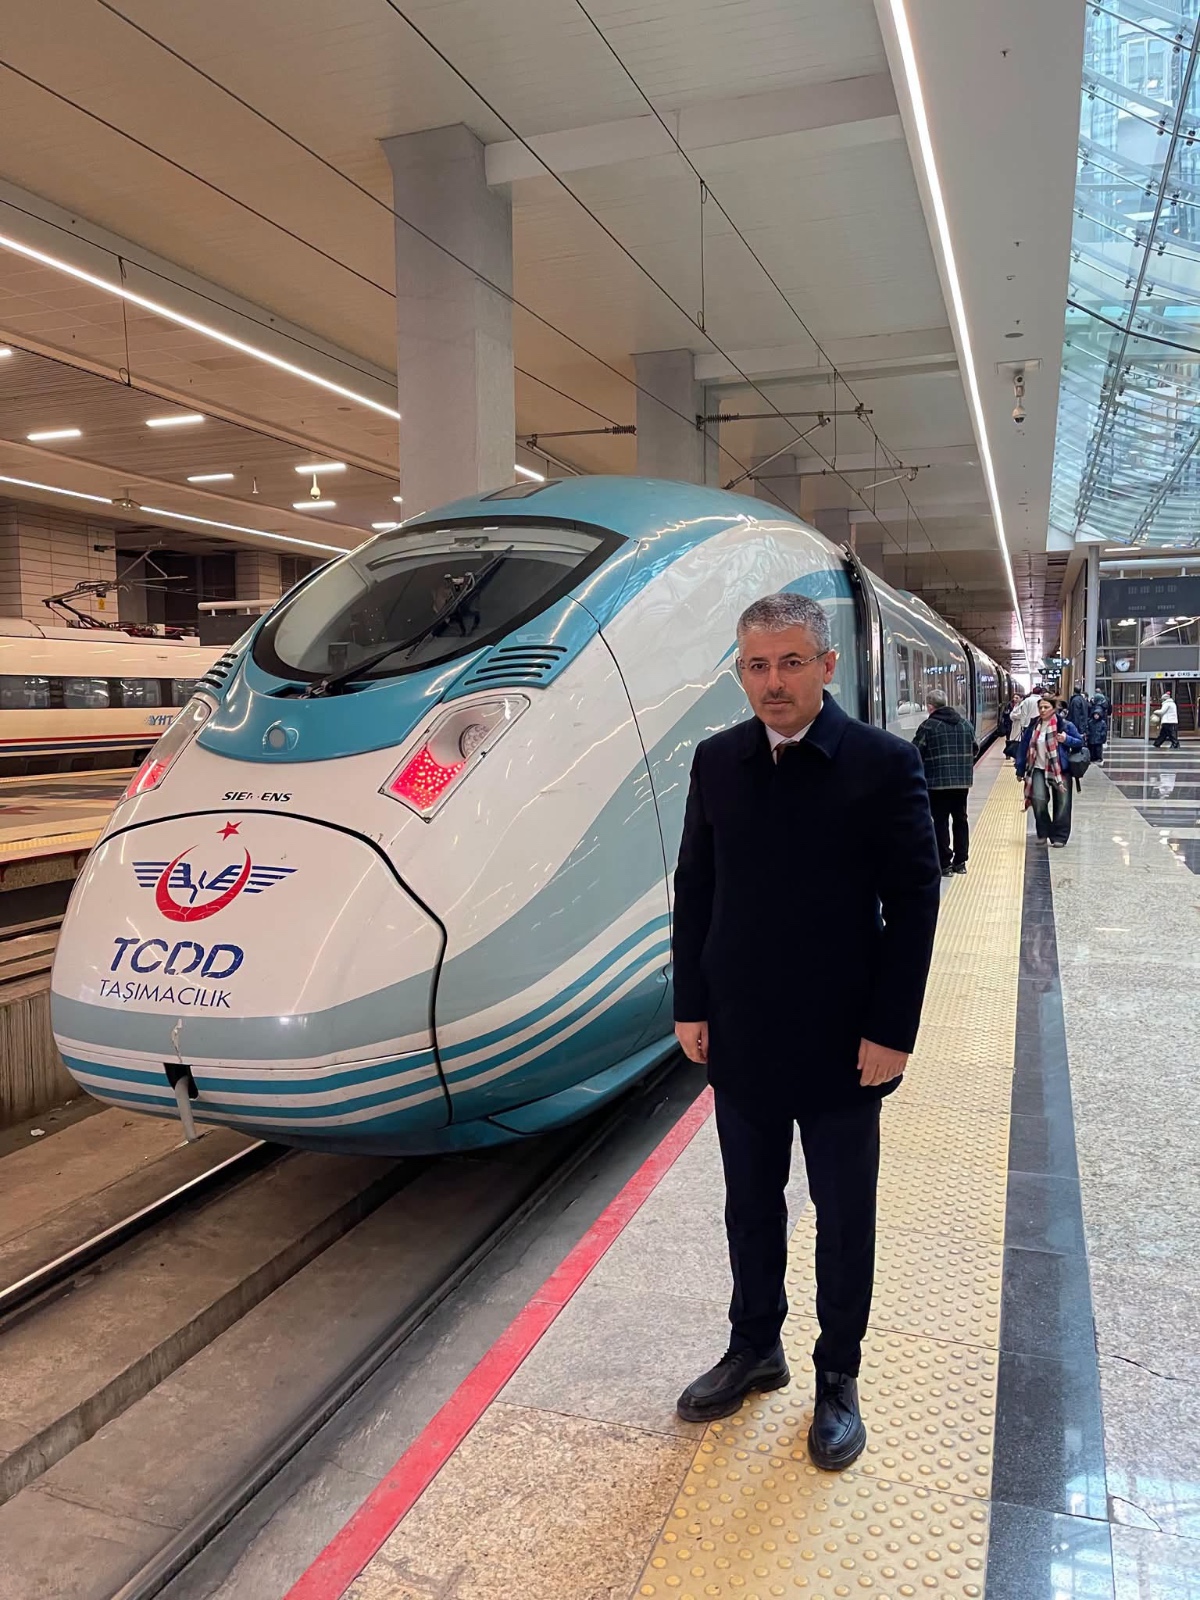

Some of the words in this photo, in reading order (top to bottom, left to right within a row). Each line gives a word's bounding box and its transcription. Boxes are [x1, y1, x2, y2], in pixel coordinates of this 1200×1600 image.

[151, 715, 174, 725] YHT
[109, 937, 244, 979] TCDD
[99, 979, 232, 1008] TAŞIMACILIK
